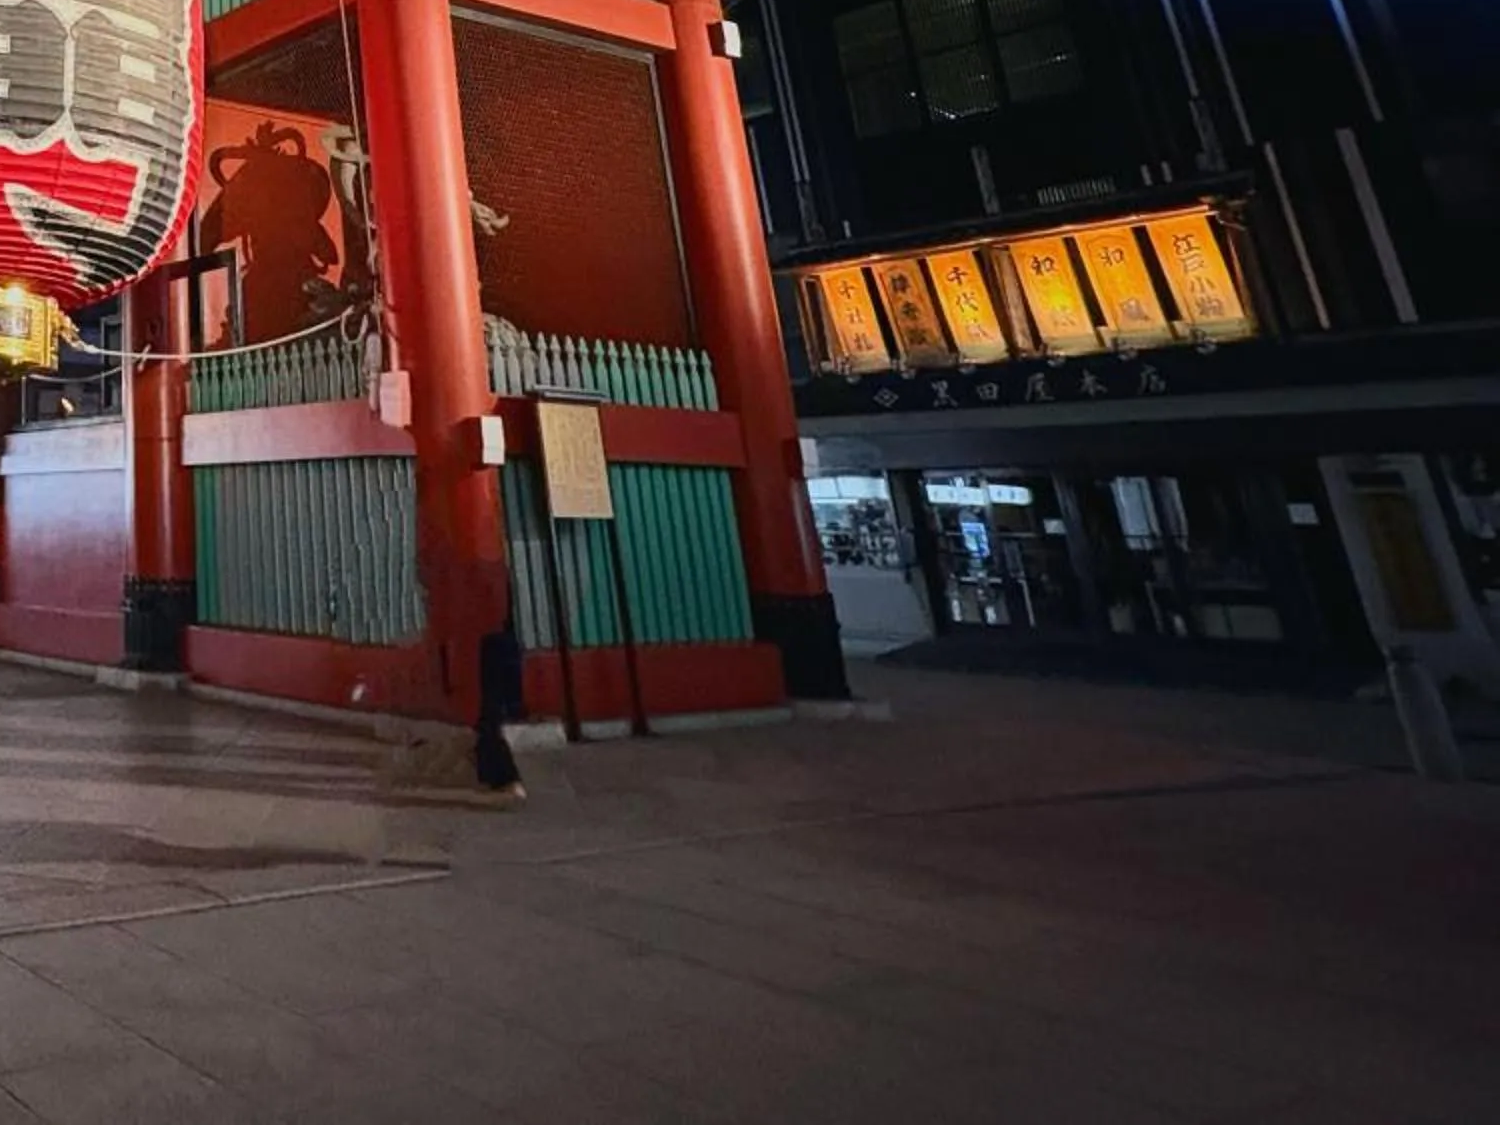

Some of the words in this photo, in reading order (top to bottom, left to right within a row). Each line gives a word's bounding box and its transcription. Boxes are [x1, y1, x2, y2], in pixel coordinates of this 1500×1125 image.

[1171, 233, 1224, 318] 江戸小物
[929, 363, 1167, 409] 黒田屋本店
